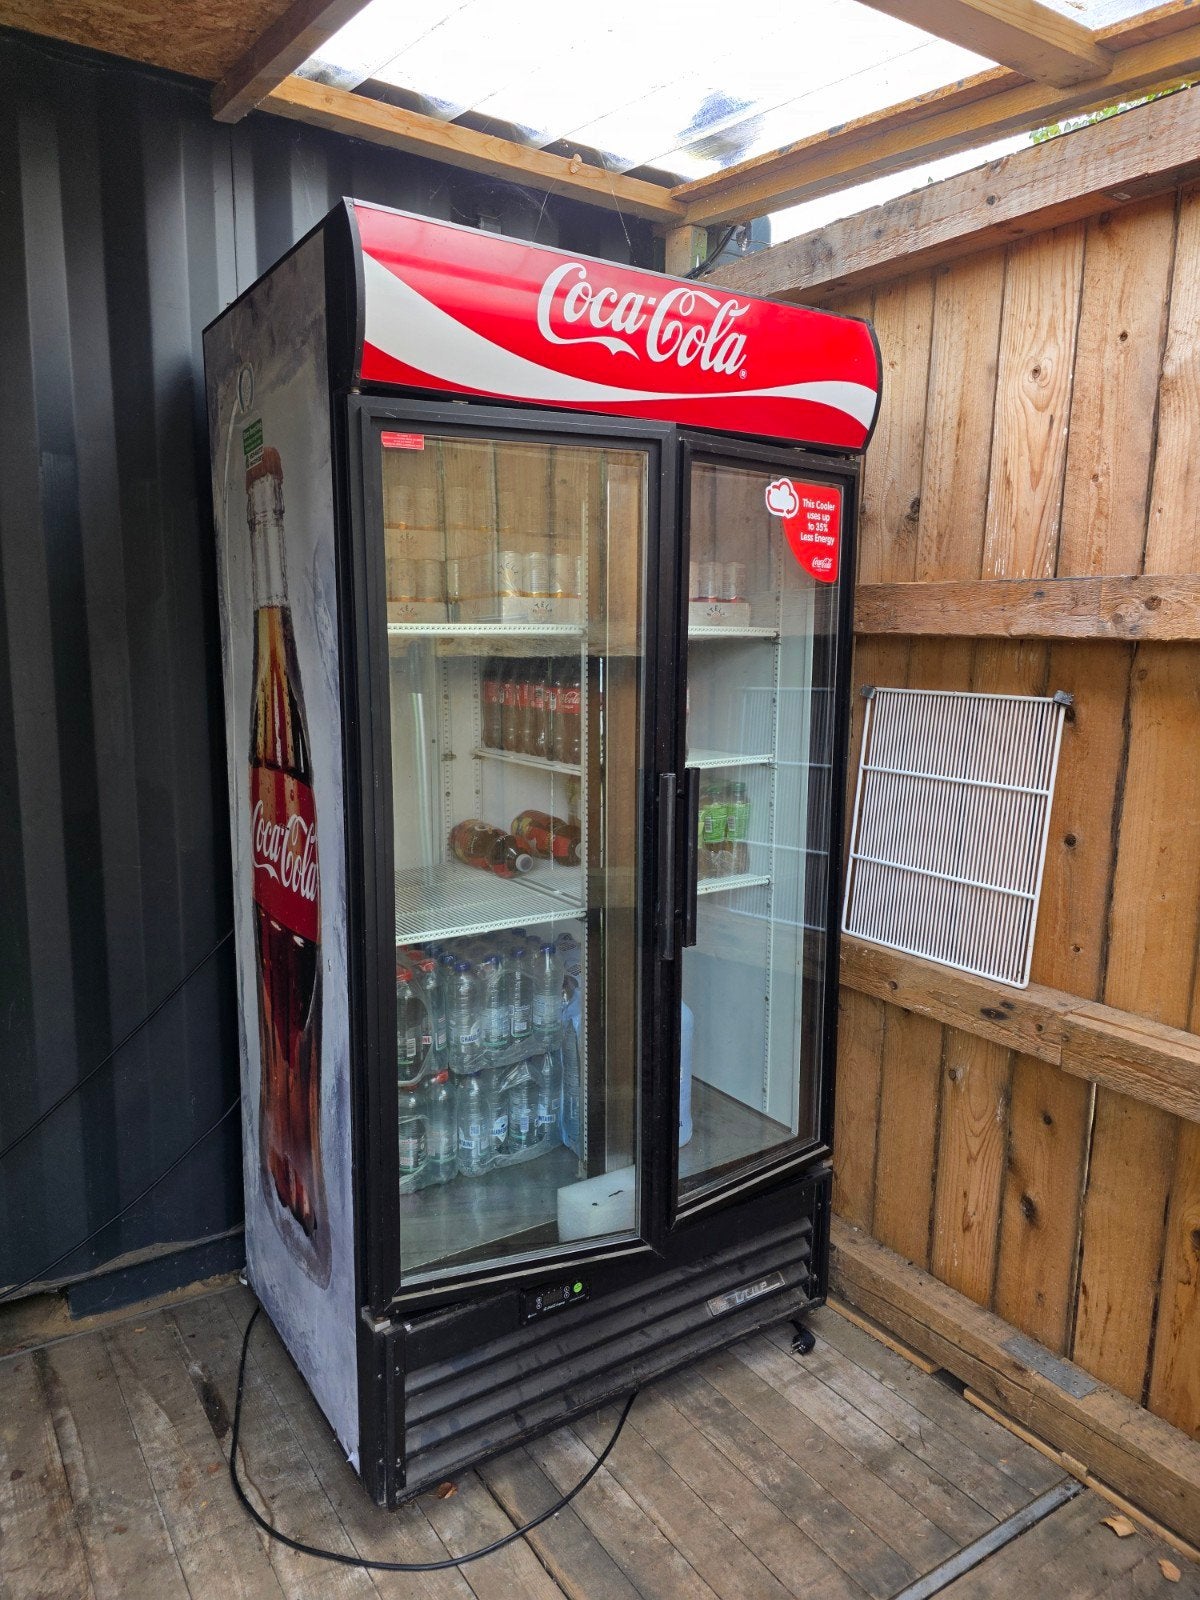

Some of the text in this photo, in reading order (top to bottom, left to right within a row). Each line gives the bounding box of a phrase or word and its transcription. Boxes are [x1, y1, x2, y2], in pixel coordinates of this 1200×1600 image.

[536, 262, 750, 376] Coca-Cola
[803, 499, 835, 511] This Cooler
[807, 512, 830, 523] uses up
[808, 523, 828, 532] to 35%
[800, 532, 835, 545] Less Energy
[252, 799, 319, 902] Coca-Cola
